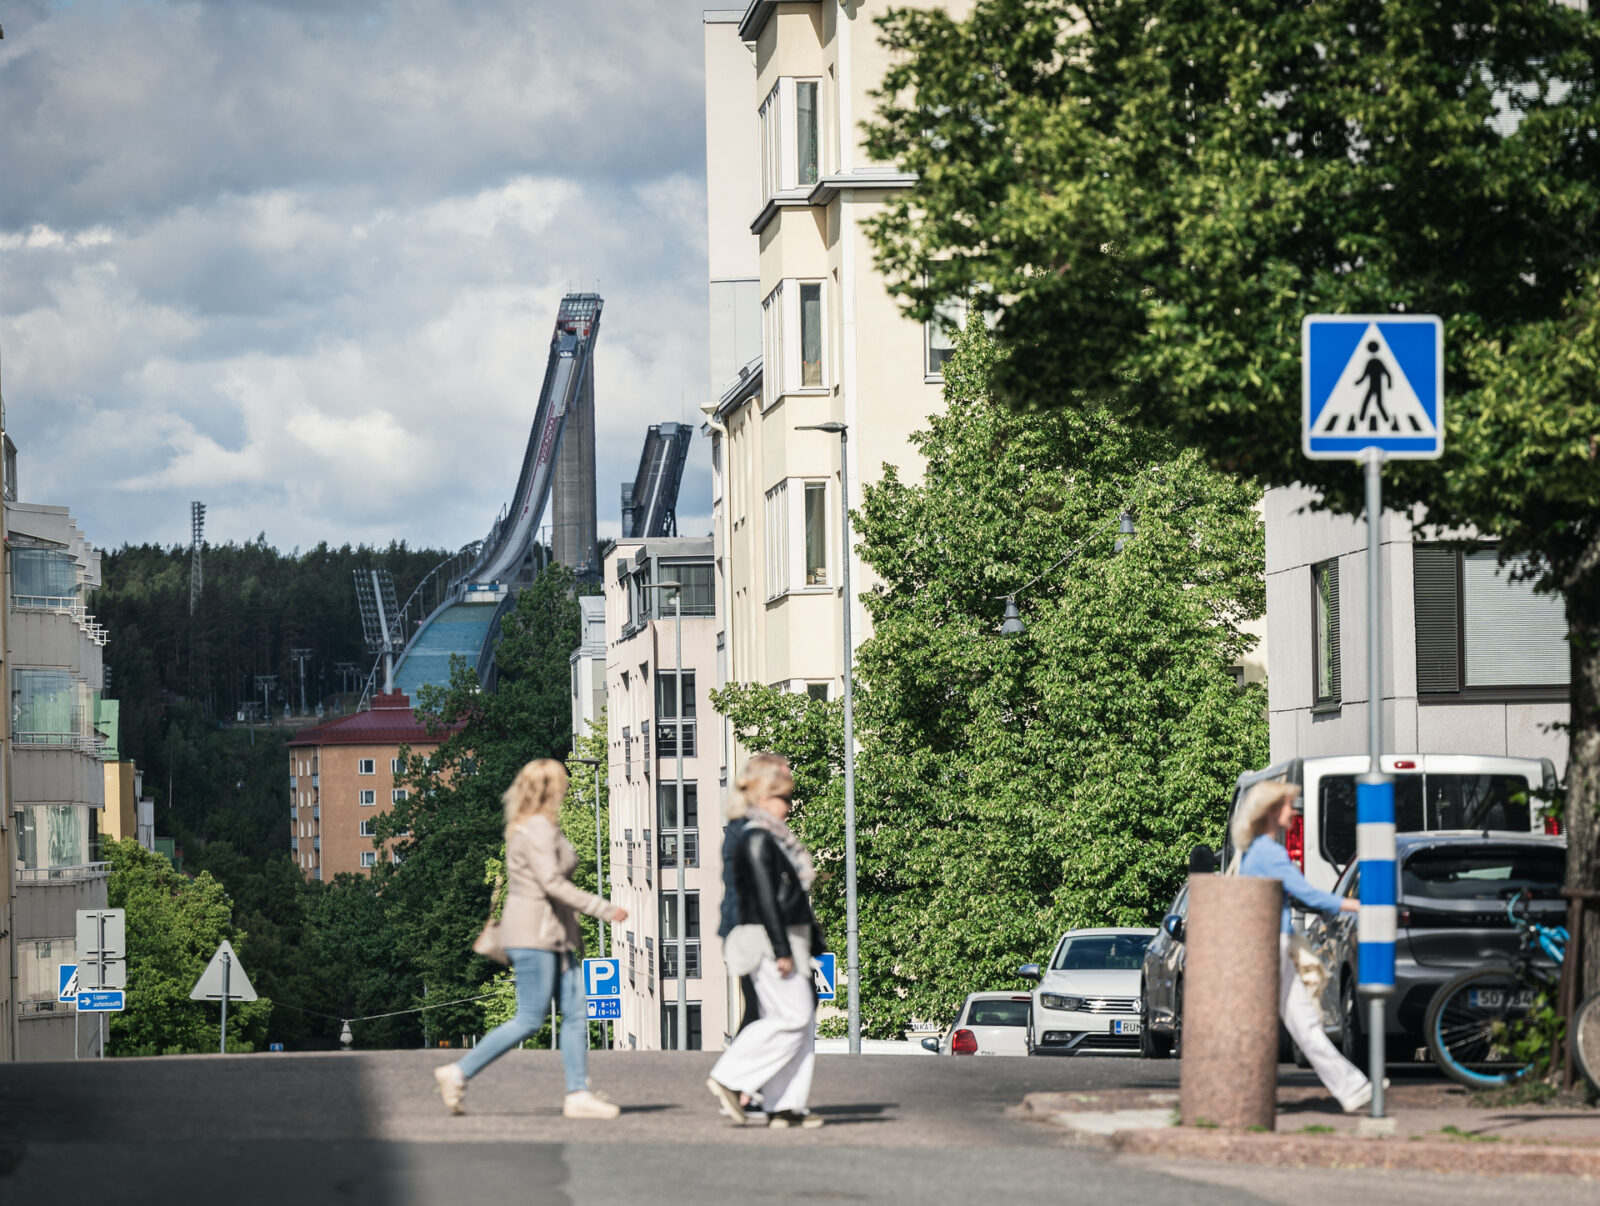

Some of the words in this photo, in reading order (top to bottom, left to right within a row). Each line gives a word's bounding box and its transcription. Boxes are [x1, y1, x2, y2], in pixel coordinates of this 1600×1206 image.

[589, 961, 615, 994] P
[611, 985, 618, 994] D
[598, 1008, 620, 1016] (8-16)
